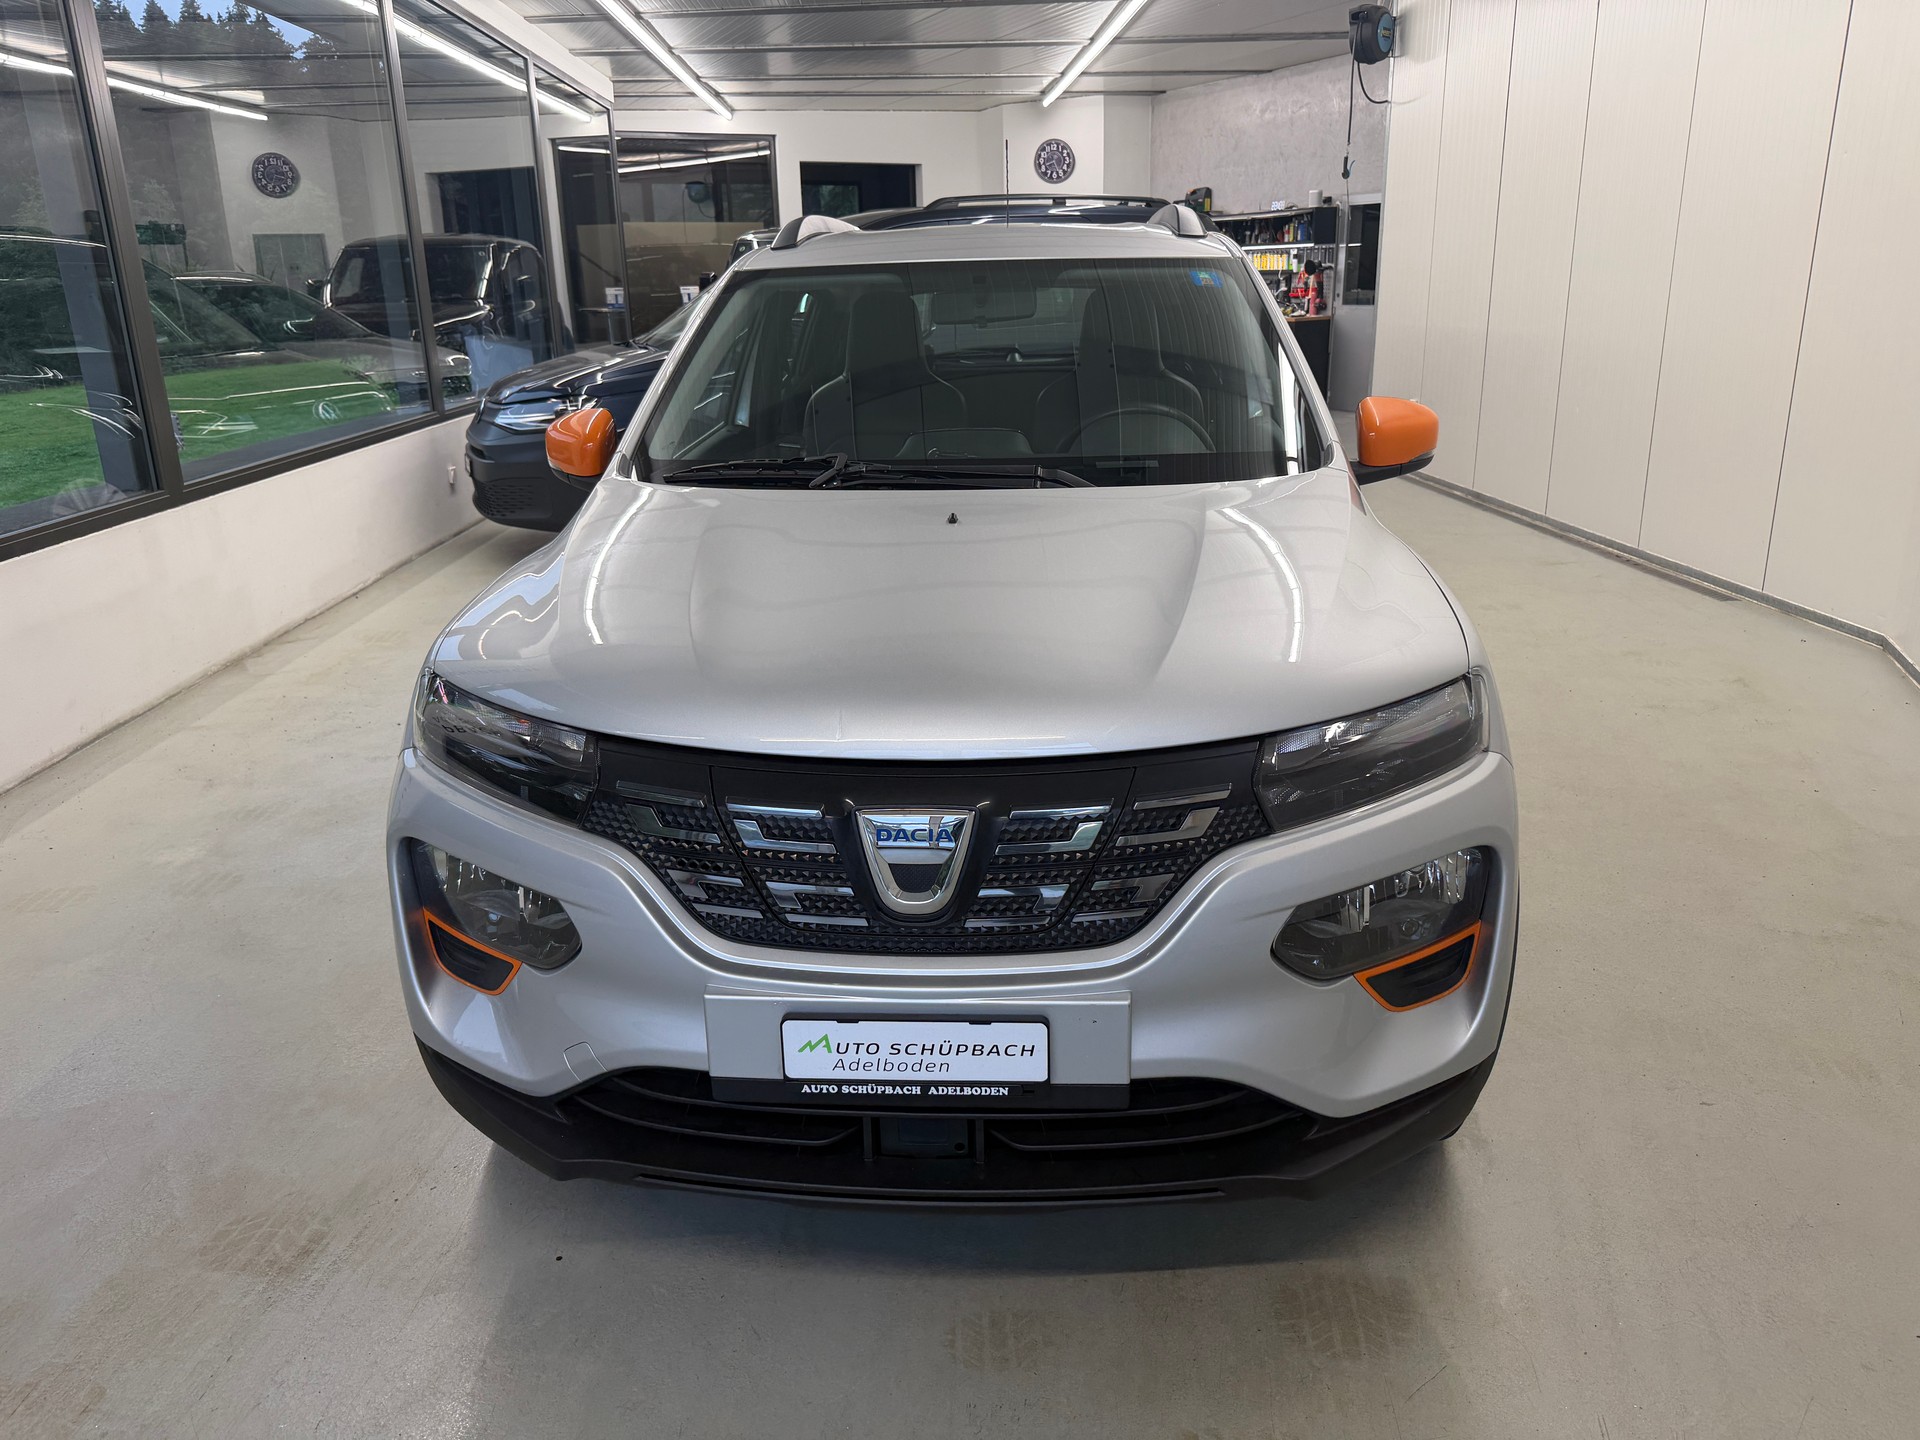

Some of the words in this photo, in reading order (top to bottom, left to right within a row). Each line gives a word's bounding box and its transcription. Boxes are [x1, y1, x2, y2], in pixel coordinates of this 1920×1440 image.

[876, 828, 954, 843] DACIA
[889, 1040, 1036, 1057] SCHÜPBACH
[832, 1058, 951, 1073] Adelboden
[801, 1084, 839, 1094] AUTO
[841, 1082, 922, 1096] SCHÜPBACH
[928, 1085, 1010, 1096] ADELBODEN
